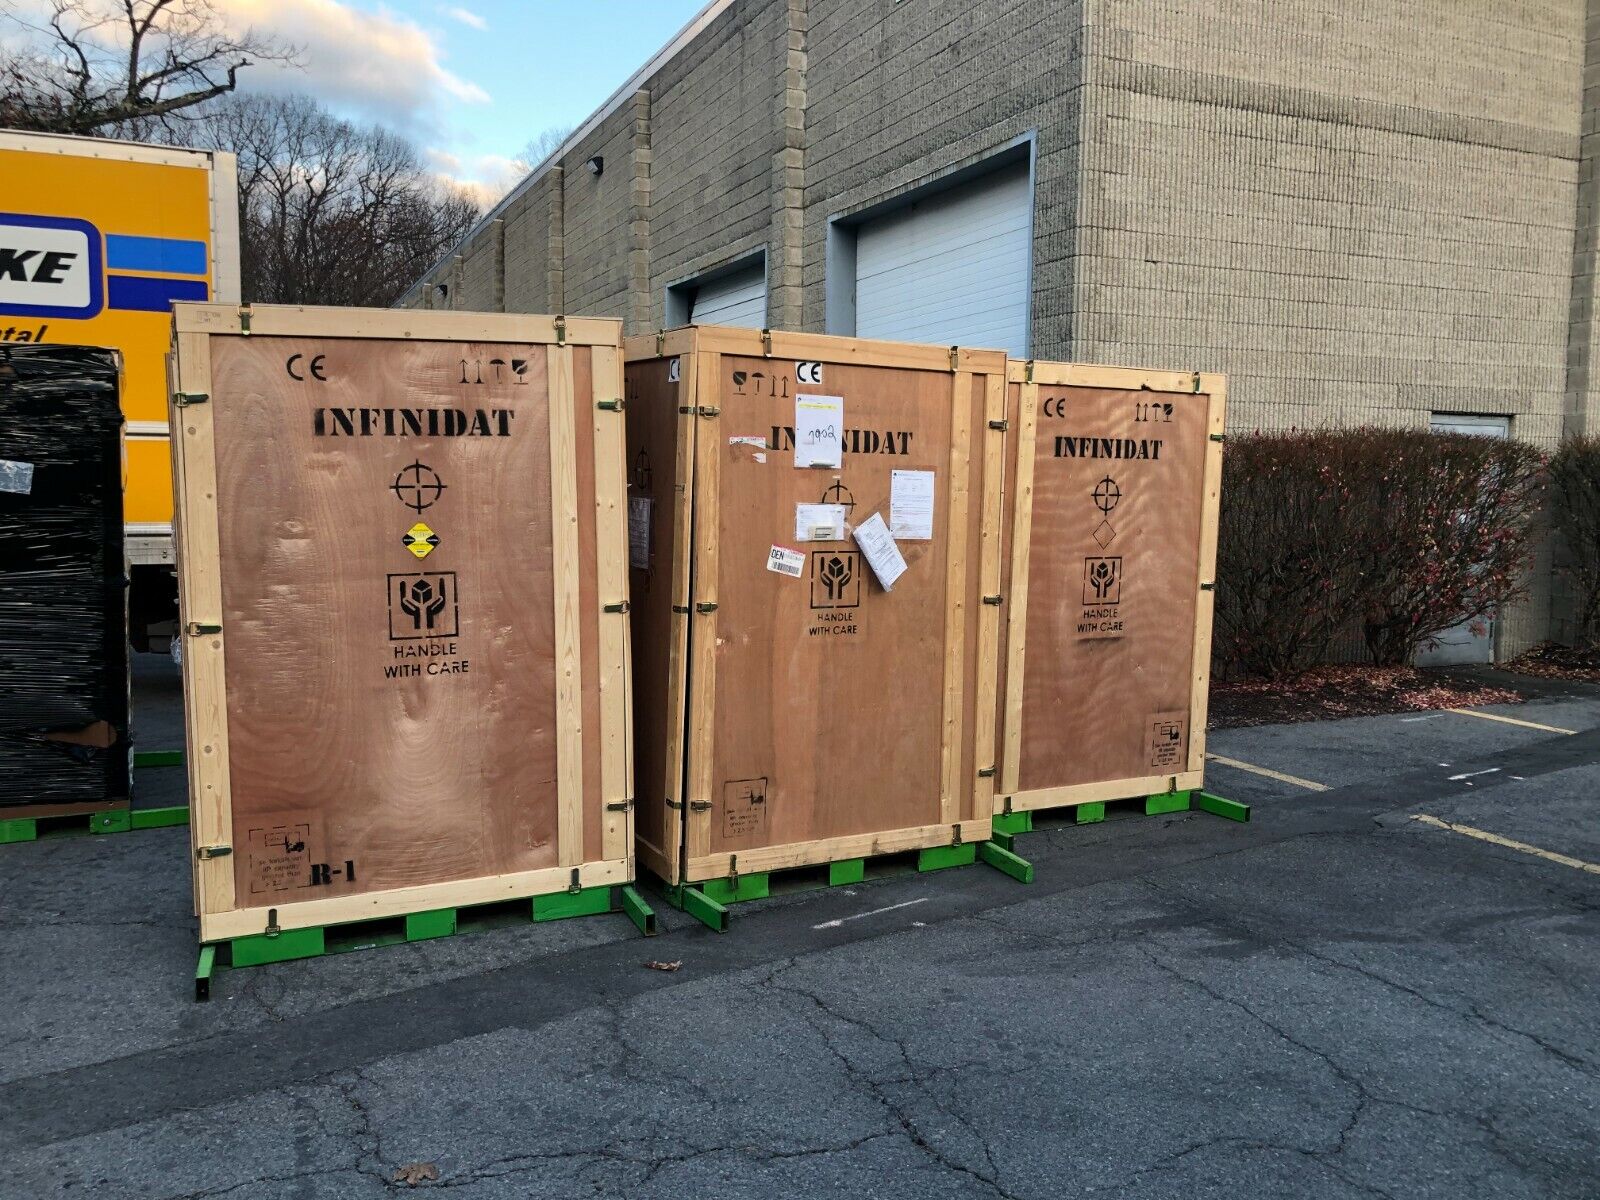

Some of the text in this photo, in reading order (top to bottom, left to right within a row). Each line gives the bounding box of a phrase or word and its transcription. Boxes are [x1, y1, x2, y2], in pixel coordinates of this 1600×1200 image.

[0, 325, 49, 343] tal
[796, 362, 822, 383] CE
[313, 407, 515, 437] INFINIDAT
[1054, 436, 1163, 460] INFINIDAT
[817, 612, 853, 622] HANDLE
[1083, 608, 1118, 619] HANDLE
[809, 624, 858, 636] WITH CARE
[1077, 621, 1124, 633] WITH CARE
[394, 642, 457, 658] HANDLE
[384, 660, 469, 679] WITH CARE
